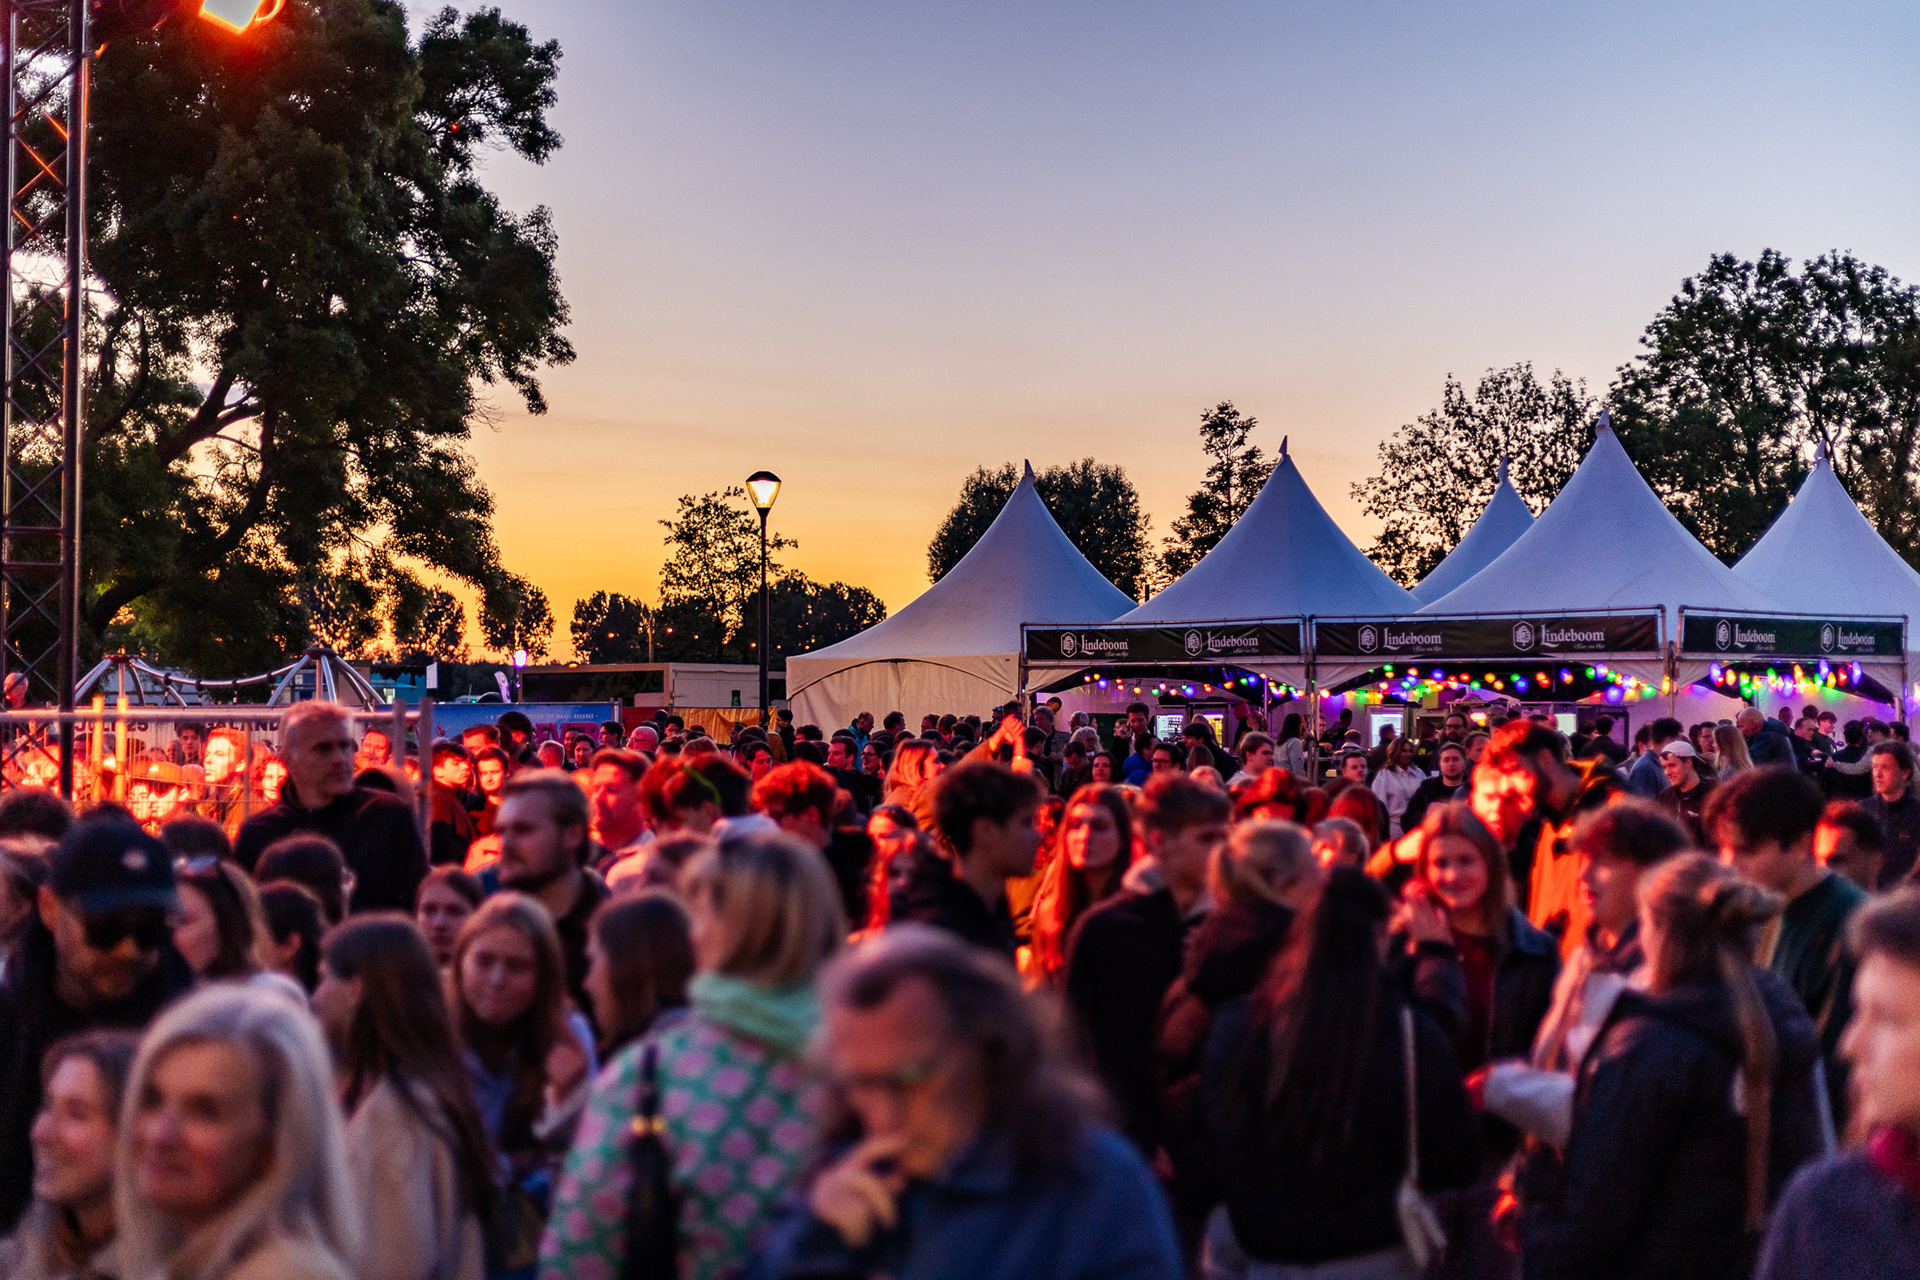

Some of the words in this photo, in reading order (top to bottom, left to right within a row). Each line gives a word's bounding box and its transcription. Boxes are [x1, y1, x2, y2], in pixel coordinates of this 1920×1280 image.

[1081, 634, 1129, 655] Lindeboom
[1207, 631, 1259, 653] Lindeboom
[1383, 627, 1442, 650] Lindeboom
[1540, 624, 1605, 648] Lindeboom
[1734, 623, 1776, 648] Lindeboom
[1837, 627, 1875, 650] Lindeboom
